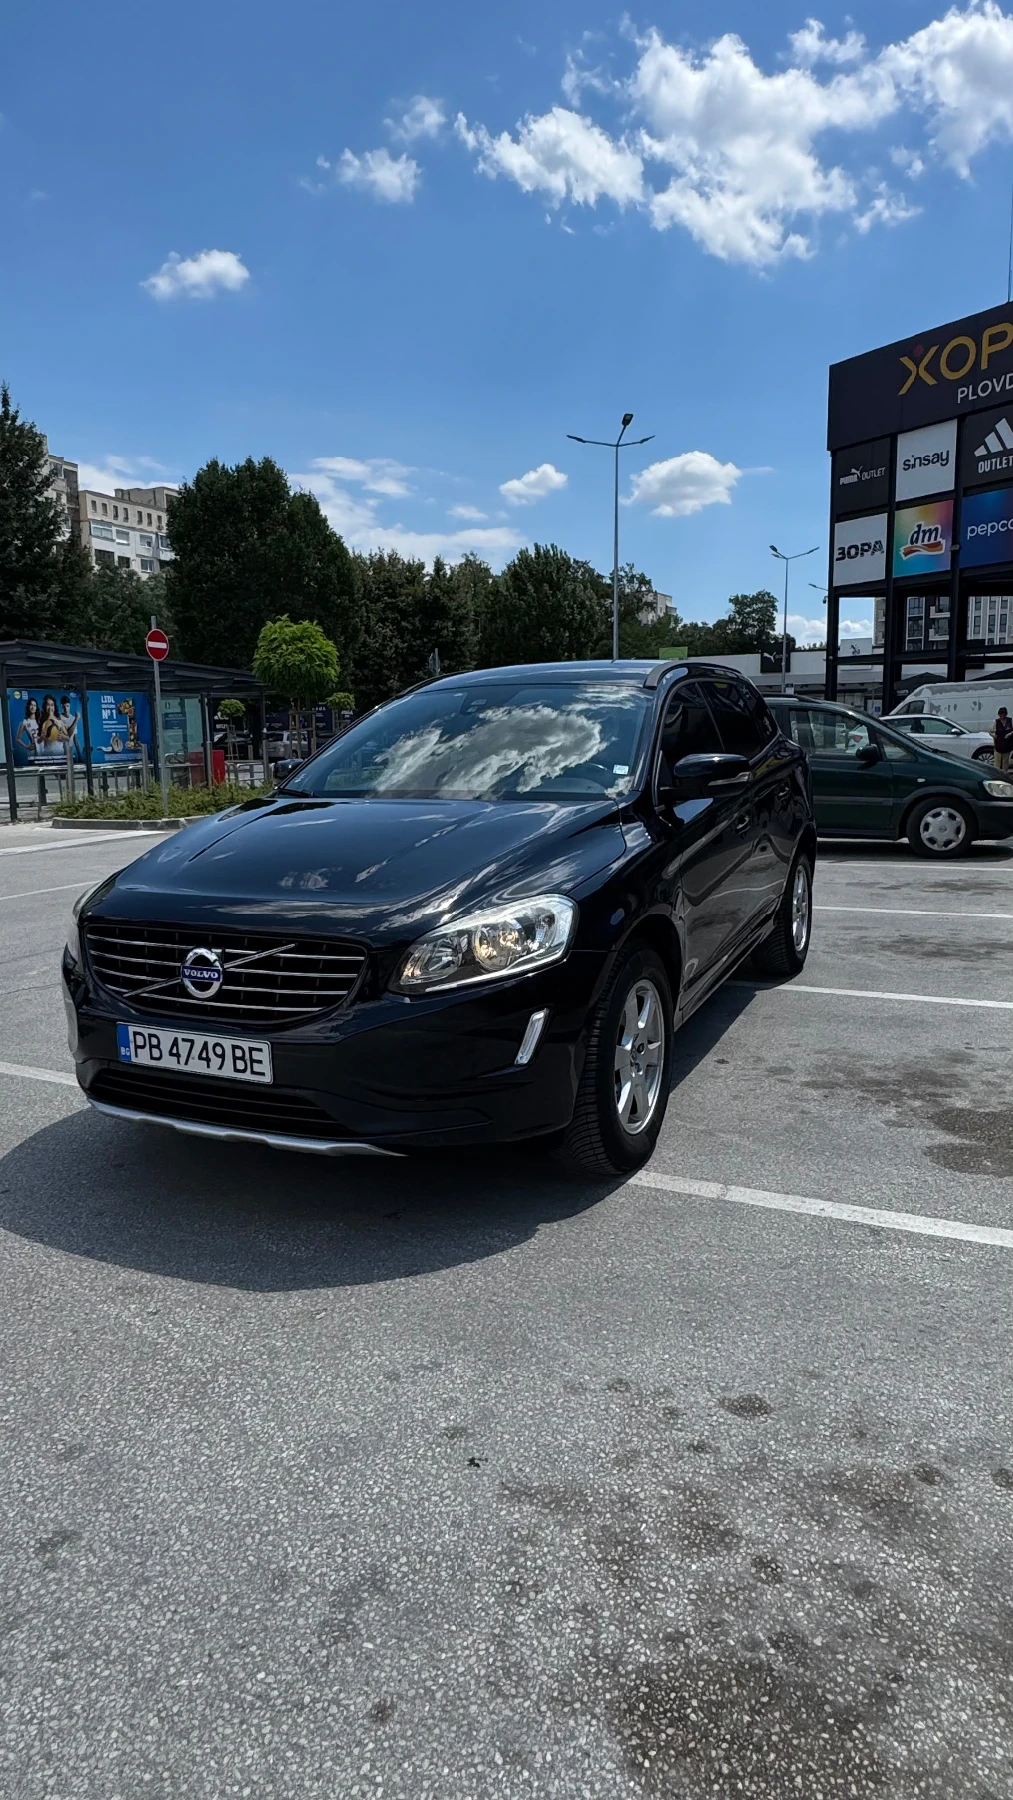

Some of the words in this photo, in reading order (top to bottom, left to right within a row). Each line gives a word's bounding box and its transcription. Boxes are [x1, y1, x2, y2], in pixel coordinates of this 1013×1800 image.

[902, 450, 949, 471] sinsay
[978, 455, 1013, 473] OUTLET
[861, 467, 886, 481] OUTLET
[909, 523, 940, 545] dm
[100, 695, 116, 704] LIDL
[112, 708, 117, 720] 1
[183, 968, 219, 979] VOLVO
[120, 1047, 131, 1056] BG
[132, 1031, 163, 1061] PB
[168, 1036, 226, 1071] 4749
[231, 1044, 266, 1077] BE
